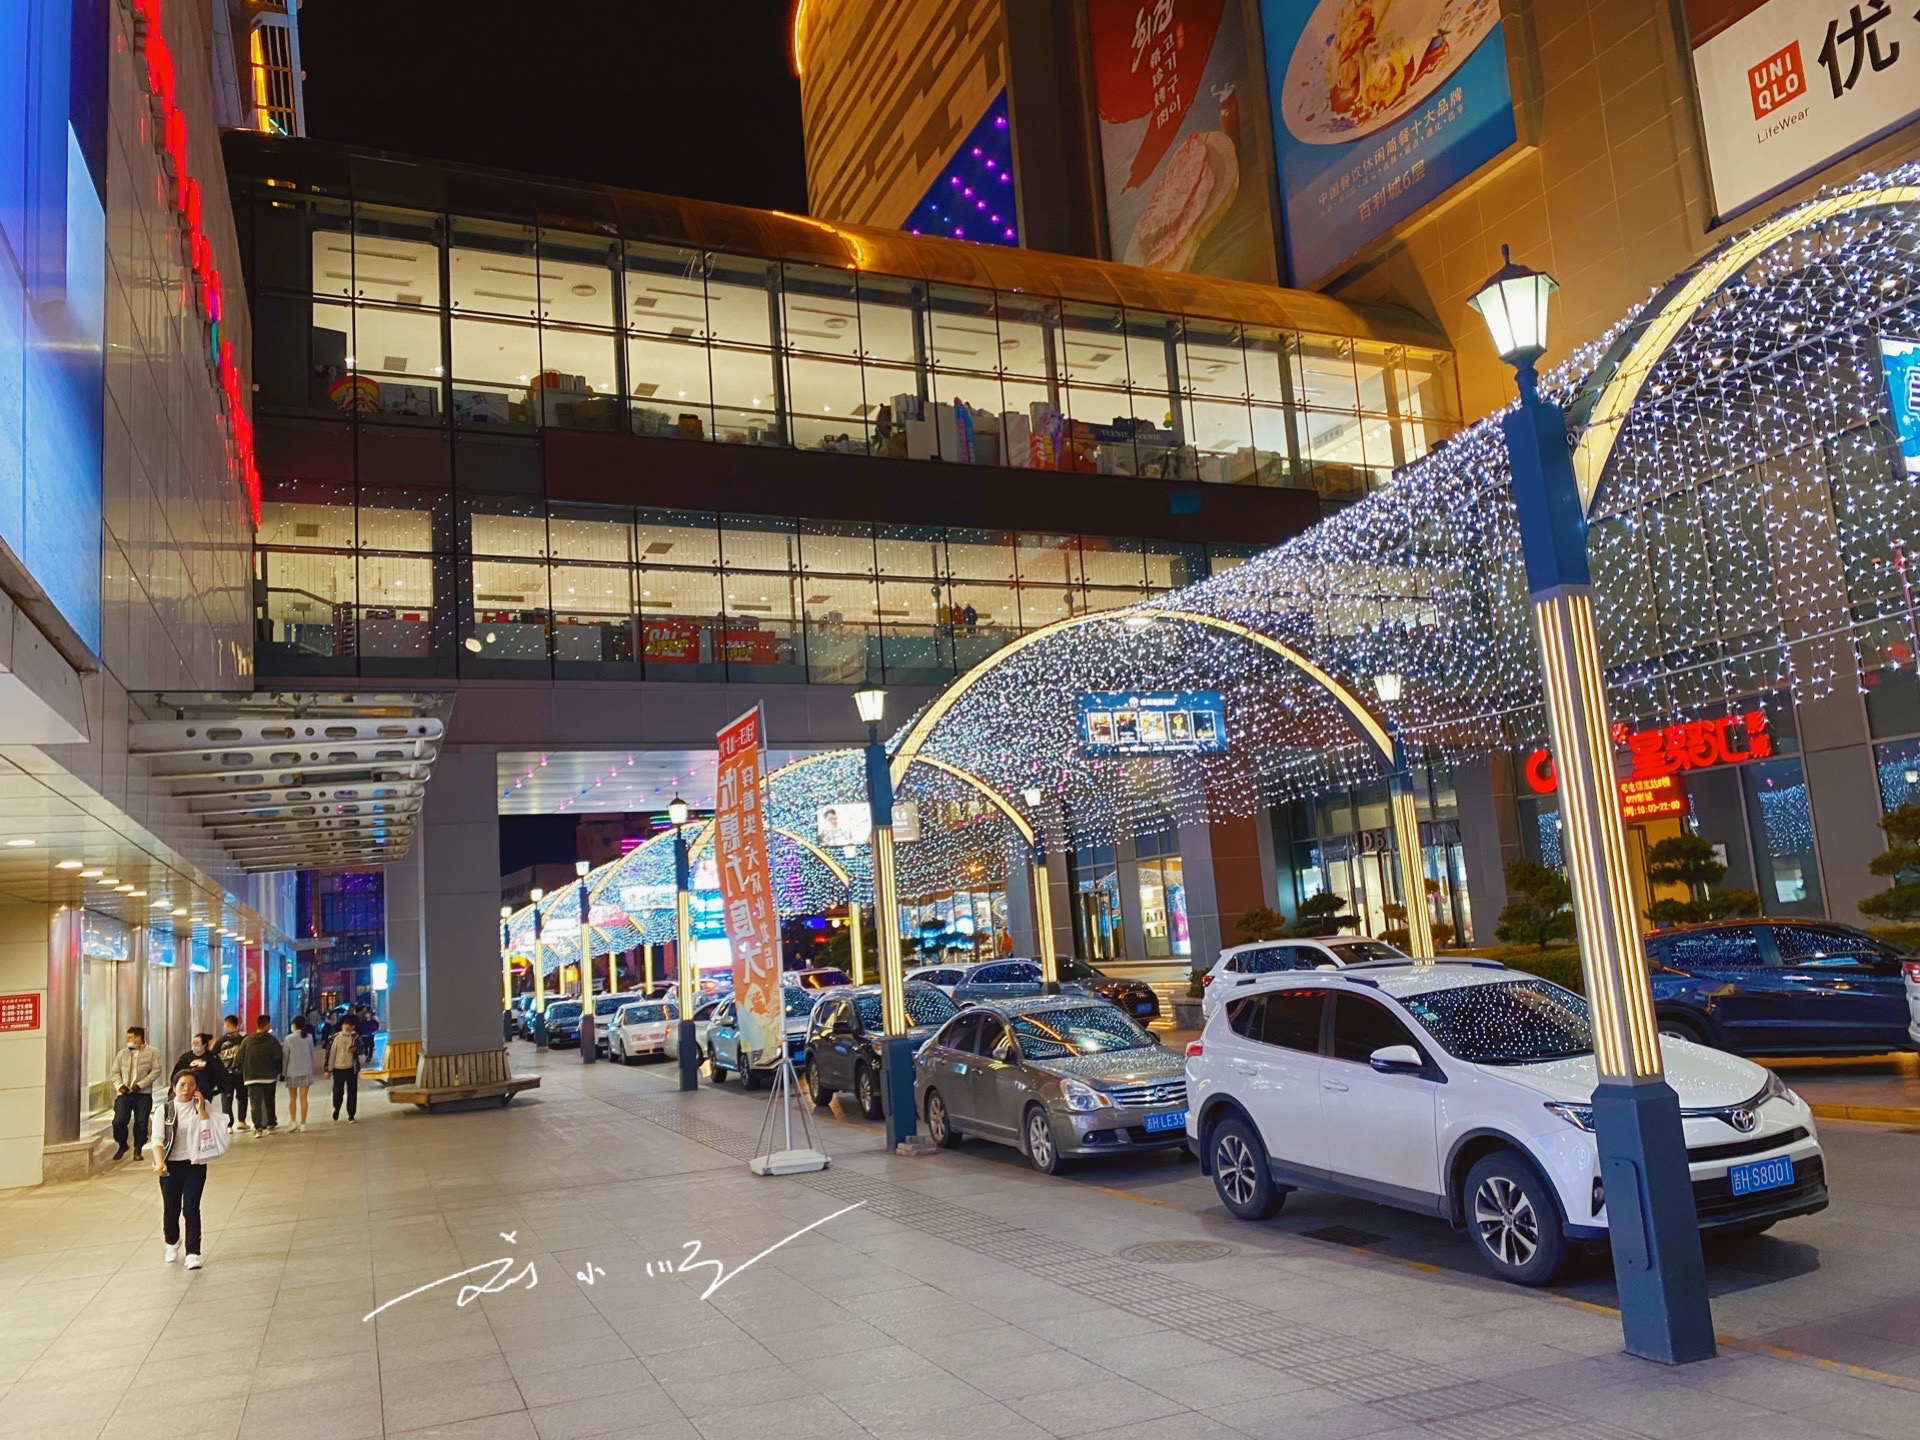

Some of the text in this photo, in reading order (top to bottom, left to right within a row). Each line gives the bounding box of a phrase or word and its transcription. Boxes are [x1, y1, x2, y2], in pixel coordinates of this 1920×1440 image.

[1162, 33, 1181, 112] 고기구이
[1754, 52, 1792, 88] UNI
[1817, 0, 1920, 99] 优
[1758, 73, 1799, 110] QLO
[1318, 86, 1464, 206] 中国餐饮休闲简餐十大品牌
[1757, 107, 1811, 143] LifeWear
[1358, 158, 1426, 222] 百利城6层
[1147, 1113, 1185, 1130] 吉HLE33
